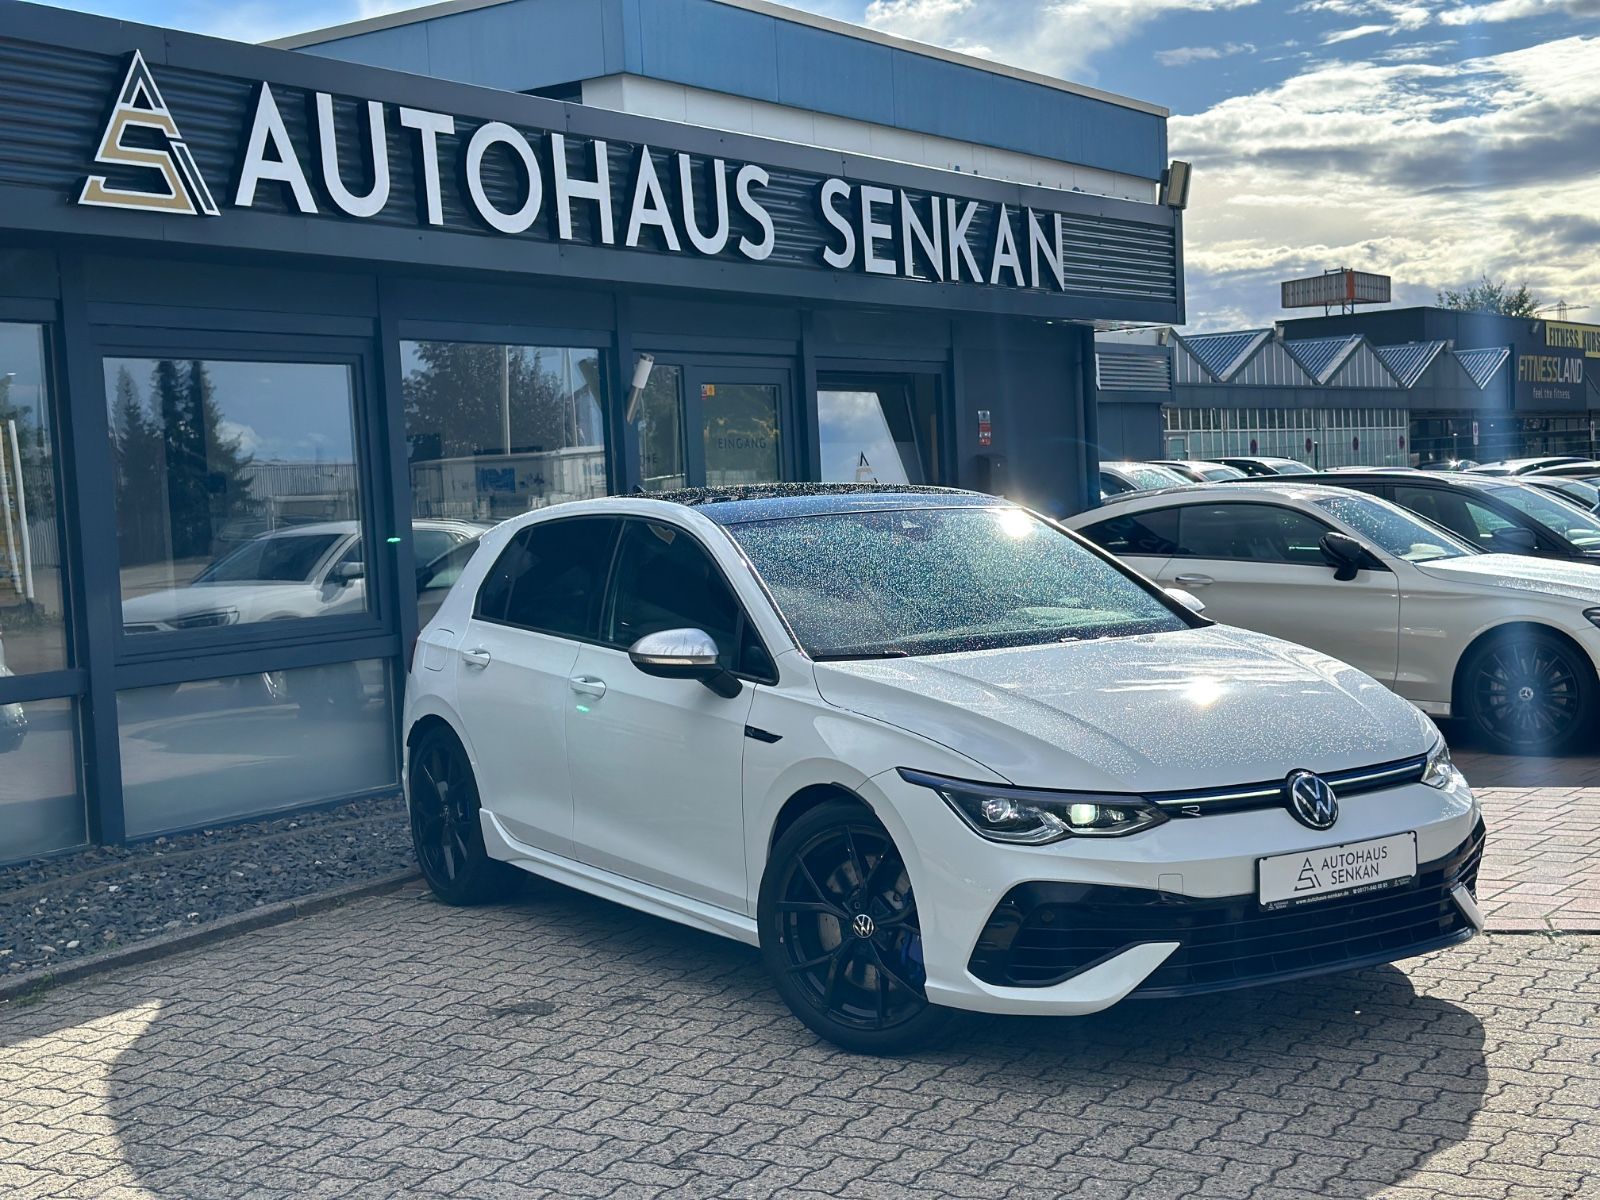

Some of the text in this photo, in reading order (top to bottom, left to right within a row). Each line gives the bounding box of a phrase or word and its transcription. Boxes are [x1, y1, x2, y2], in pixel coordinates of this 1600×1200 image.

[235, 81, 1066, 291] AUTOHAUS SENKAN
[1549, 326, 1579, 349] FITNESS
[1518, 354, 1583, 384] FITNESSLAND
[717, 437, 767, 449] EINGANG
[1321, 845, 1388, 871] AUTOHAUS
[1330, 862, 1380, 885] SENKAN
